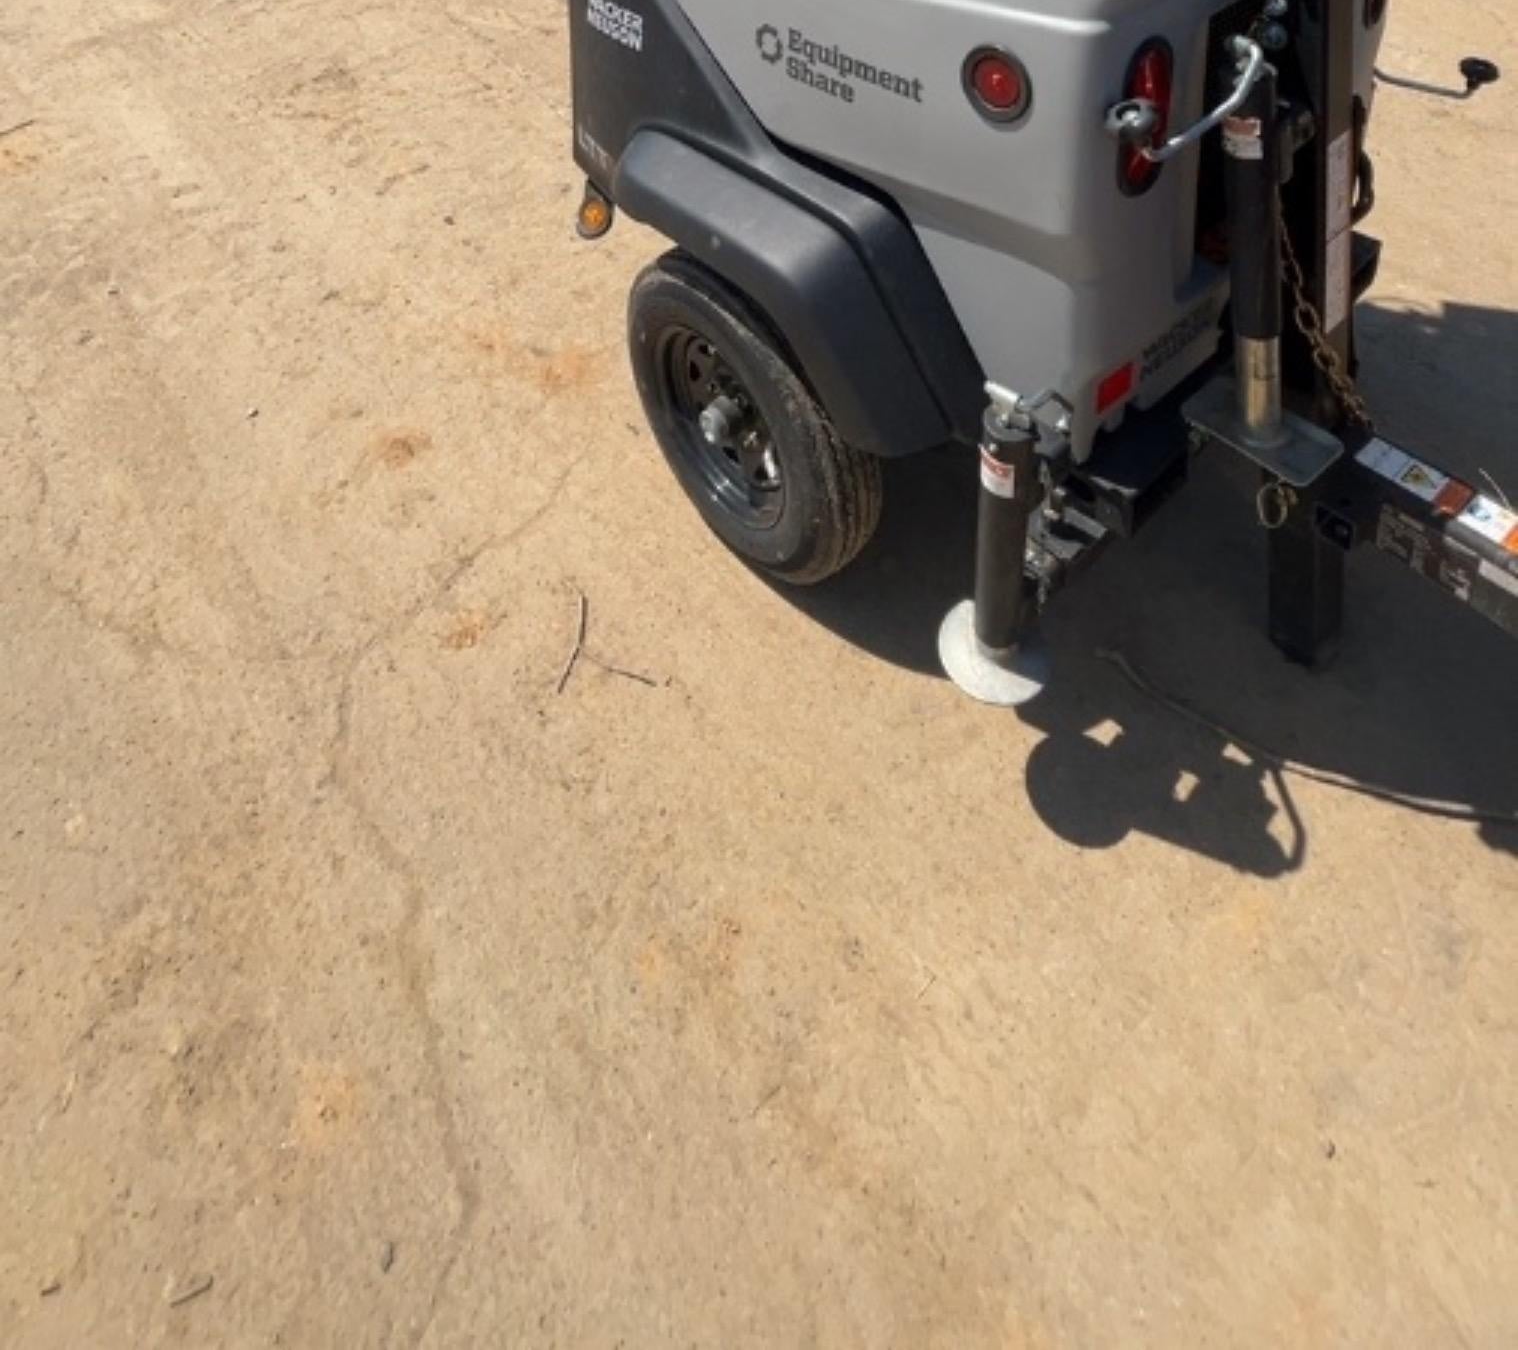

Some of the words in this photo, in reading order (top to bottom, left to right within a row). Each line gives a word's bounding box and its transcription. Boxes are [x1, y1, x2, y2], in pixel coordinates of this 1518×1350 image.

[587, 8, 643, 51] NEUSON
[786, 55, 856, 103] Share
[787, 27, 924, 103] Equipment
